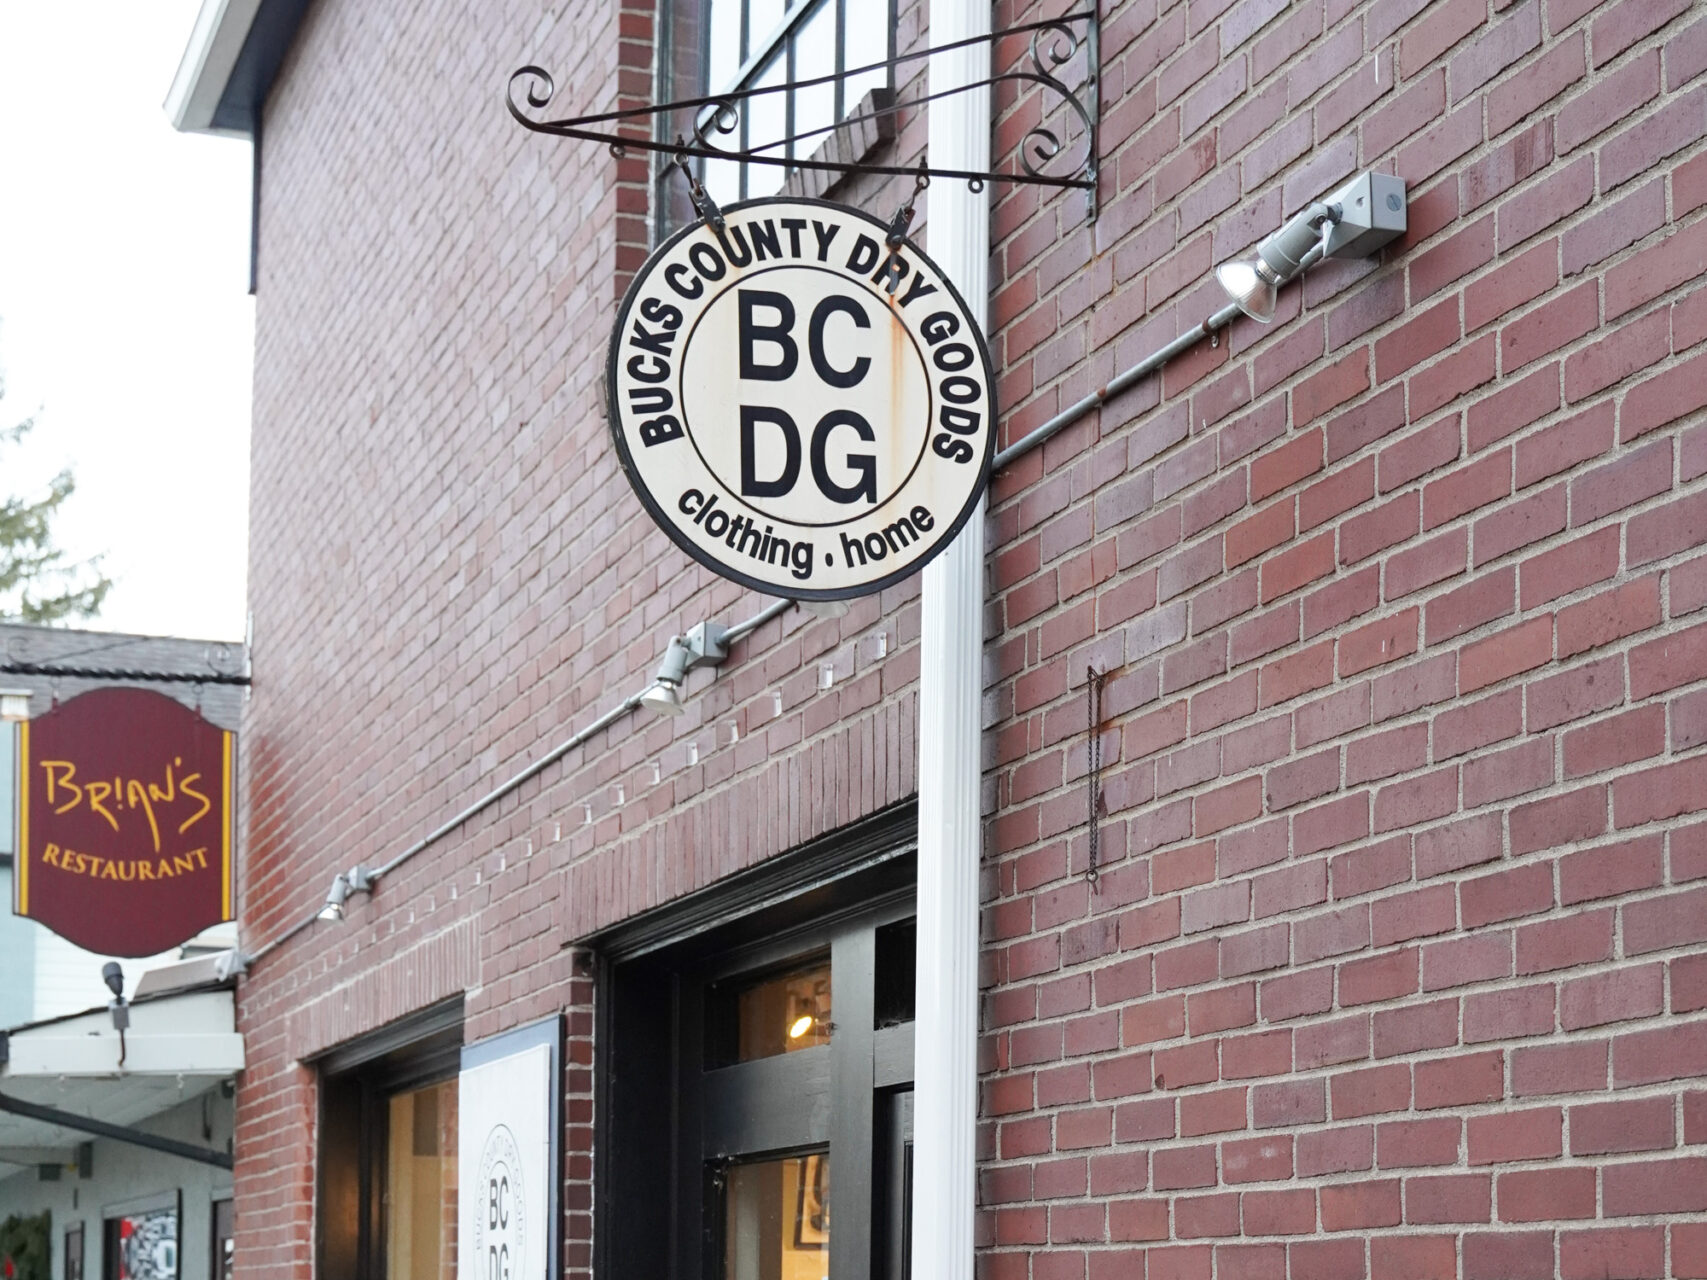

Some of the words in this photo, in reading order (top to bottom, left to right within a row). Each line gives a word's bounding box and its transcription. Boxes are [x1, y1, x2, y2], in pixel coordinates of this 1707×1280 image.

[626, 297, 685, 448] BUCKS
[664, 218, 841, 300] COUNTY
[845, 233, 938, 309] DRY
[920, 311, 982, 464] GOODS
[738, 288, 872, 389] BC
[739, 404, 878, 505] DG
[678, 488, 813, 580] clothing
[839, 504, 935, 568] home
[42, 842, 209, 881] RESTAURANT
[489, 1176, 509, 1231] BC
